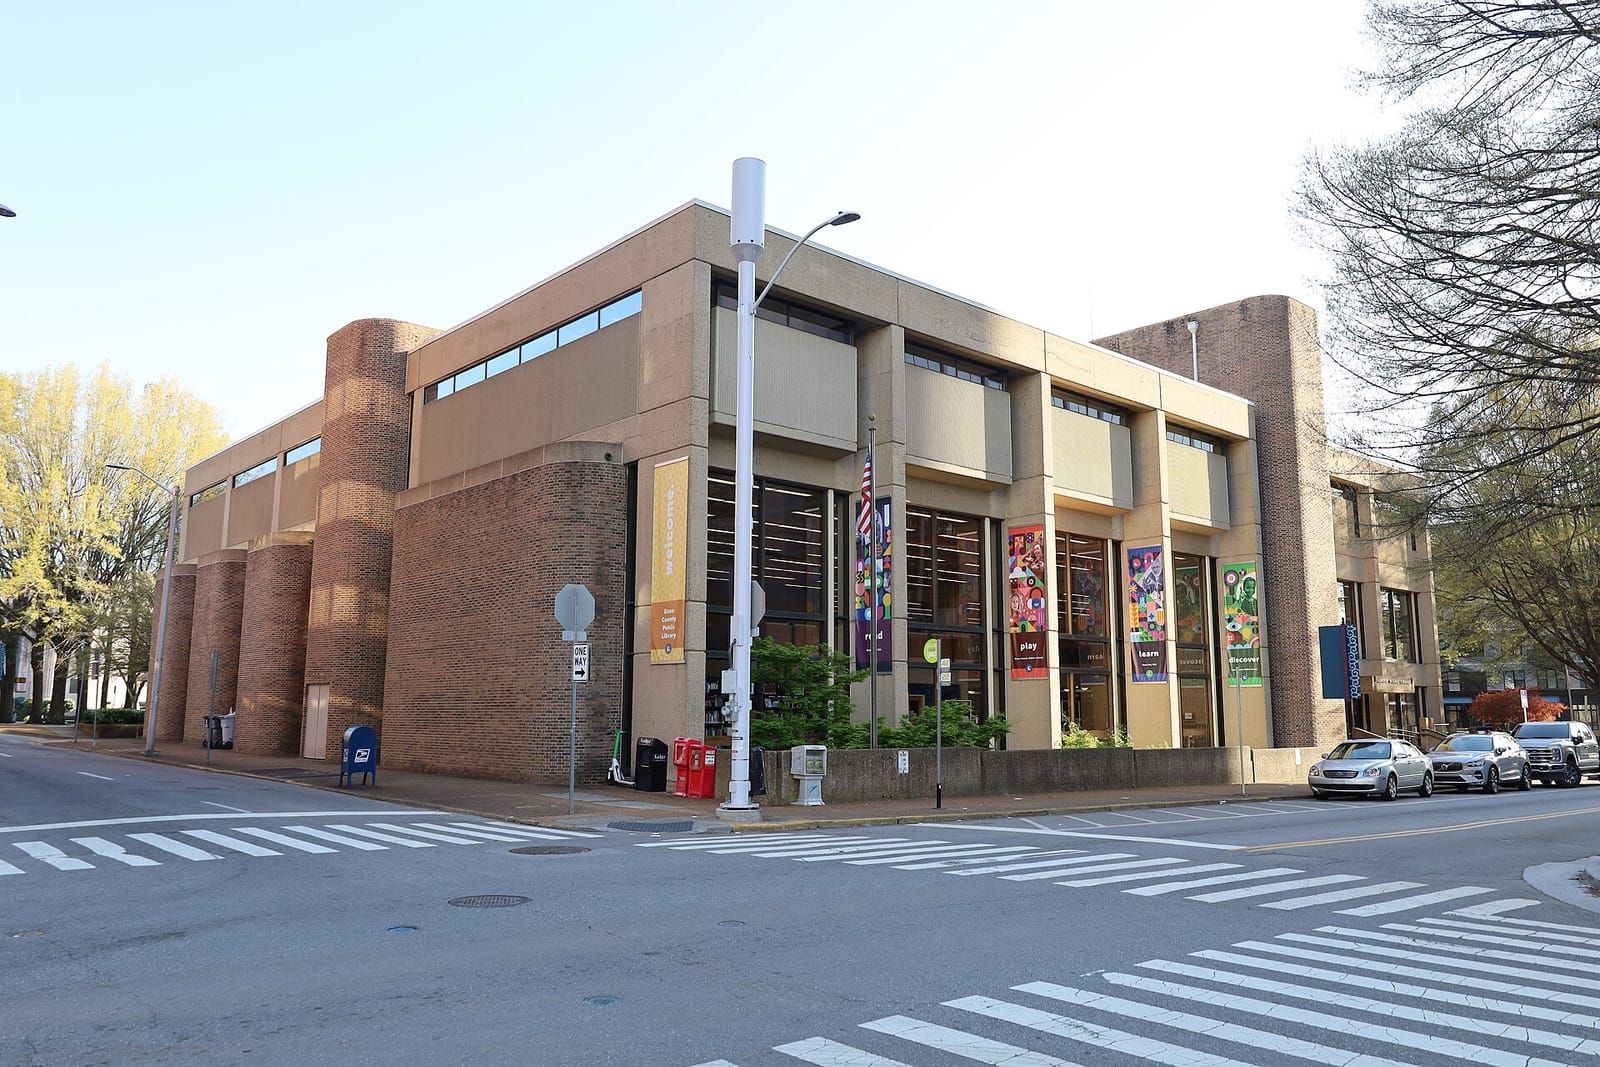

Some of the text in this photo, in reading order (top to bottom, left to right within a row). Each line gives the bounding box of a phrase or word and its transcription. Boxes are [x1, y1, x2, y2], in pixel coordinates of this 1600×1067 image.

[664, 483, 675, 576] welcome.
[865, 630, 883, 640] red
[575, 646, 587, 656] ONE
[1020, 642, 1037, 651] play
[1138, 650, 1159, 658] learn
[575, 657, 587, 666] WAY
[1228, 656, 1260, 664] discover
